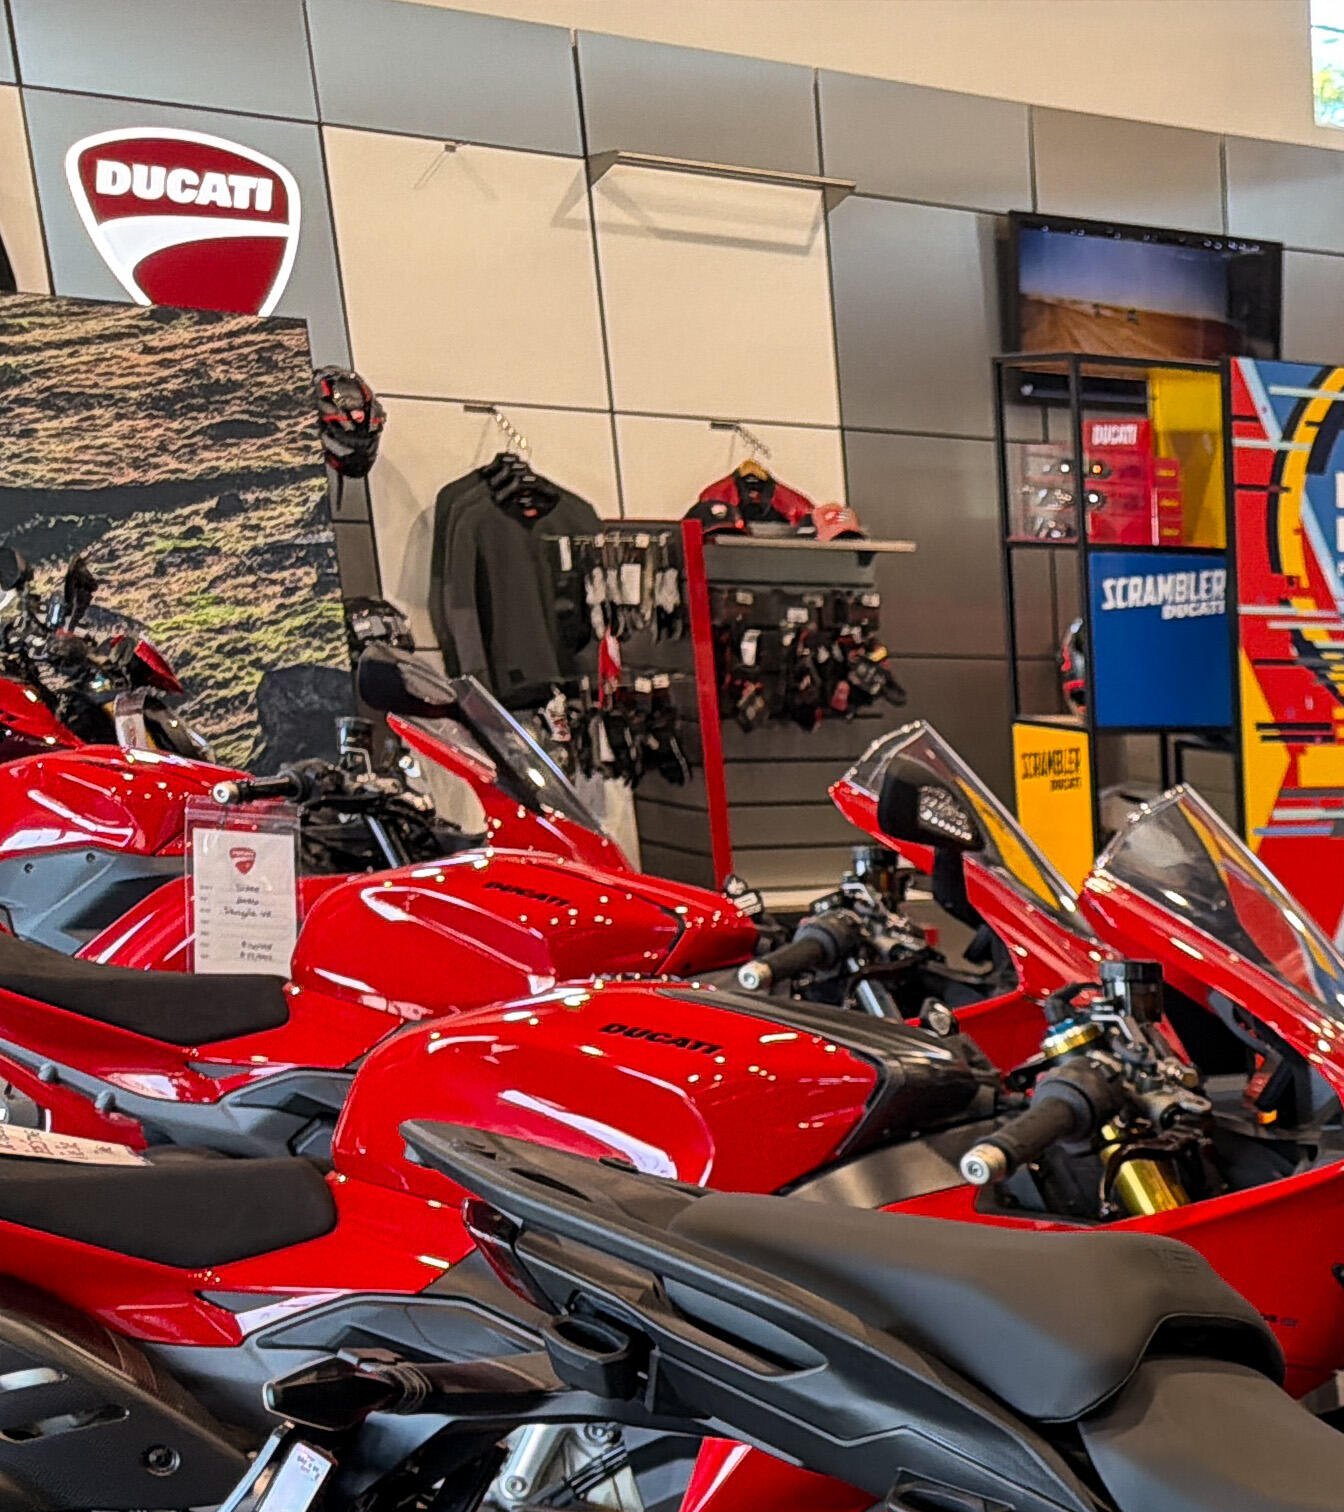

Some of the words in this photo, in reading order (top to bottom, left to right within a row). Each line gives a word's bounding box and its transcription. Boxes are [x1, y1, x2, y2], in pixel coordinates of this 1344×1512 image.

[96, 160, 273, 211] DUCATI
[1101, 569, 1226, 610] SCRAMBLER
[1161, 600, 1225, 620] DUCATI
[599, 1023, 723, 1054] DUCATI
